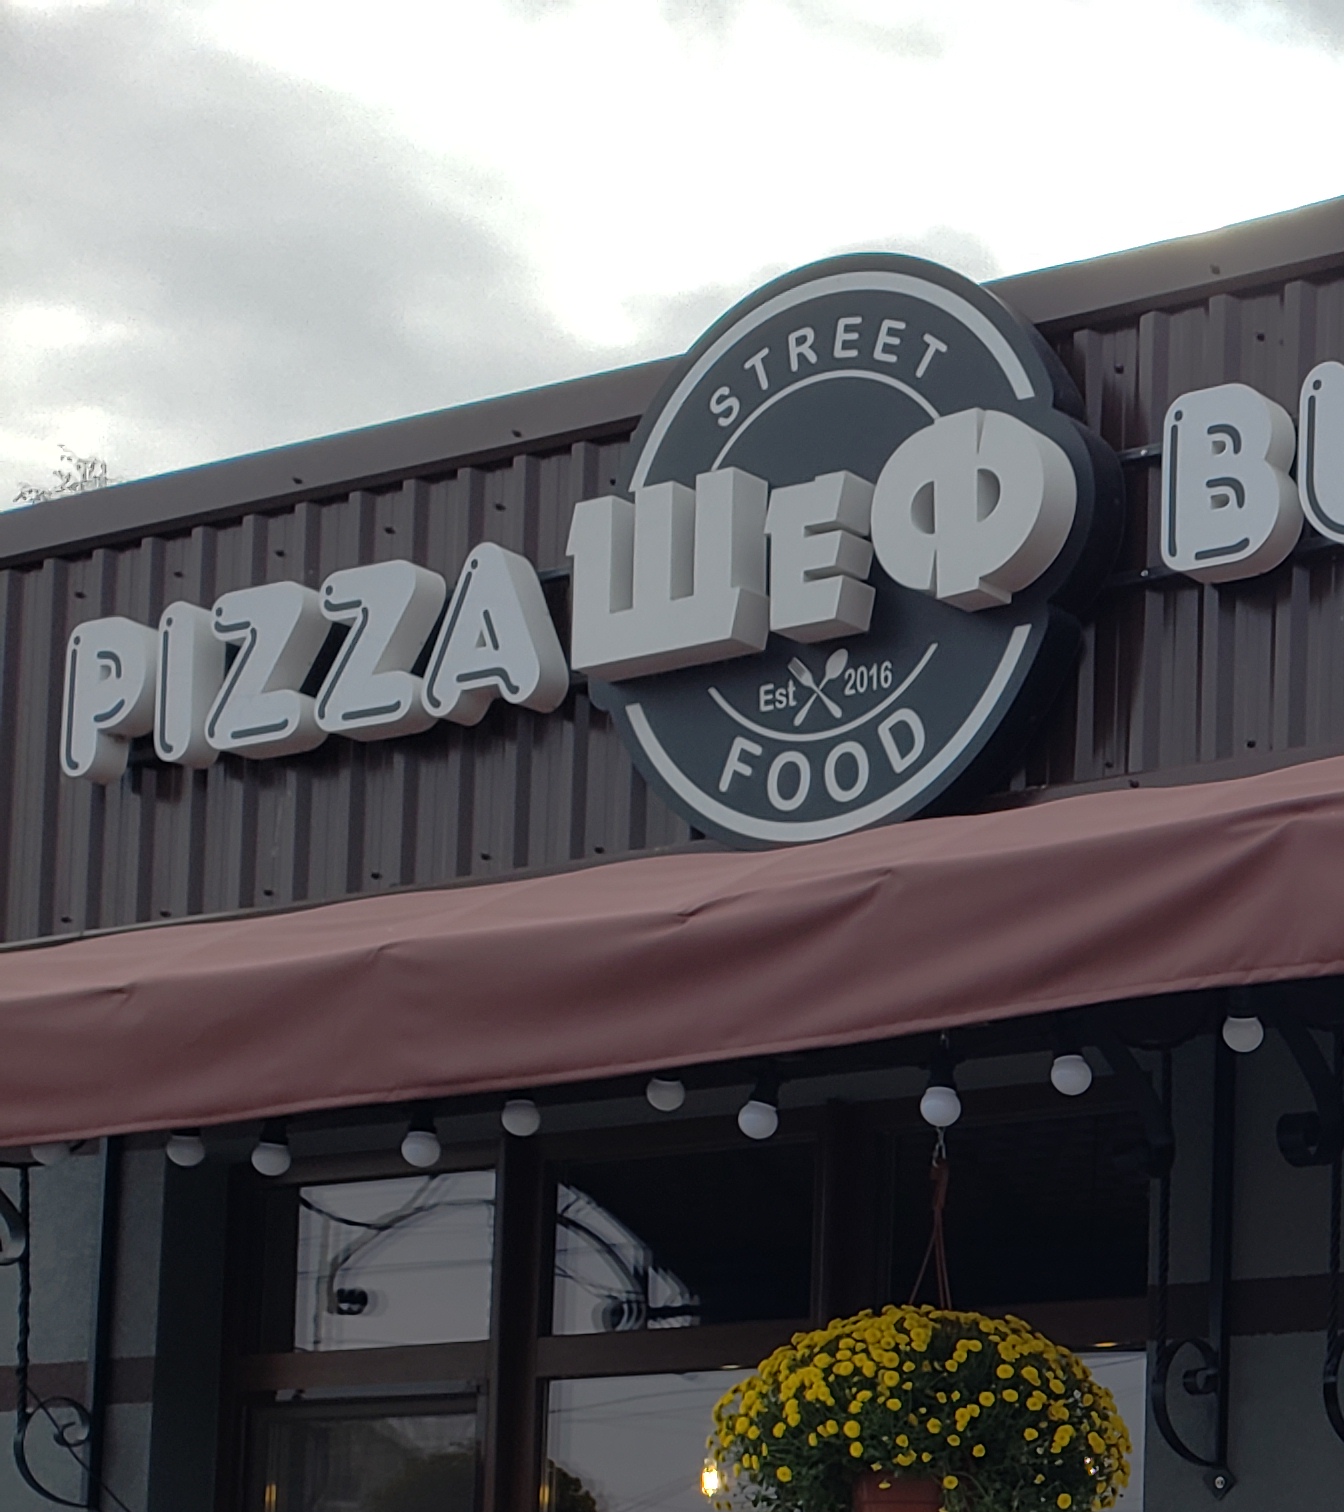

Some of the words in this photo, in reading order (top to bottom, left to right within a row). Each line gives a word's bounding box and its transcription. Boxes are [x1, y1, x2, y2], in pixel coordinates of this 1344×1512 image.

[709, 316, 948, 428] STREET
[60, 541, 571, 785] PIZZA
[758, 678, 797, 712] Est
[843, 660, 893, 696] 2016
[718, 707, 926, 812] FOOD
